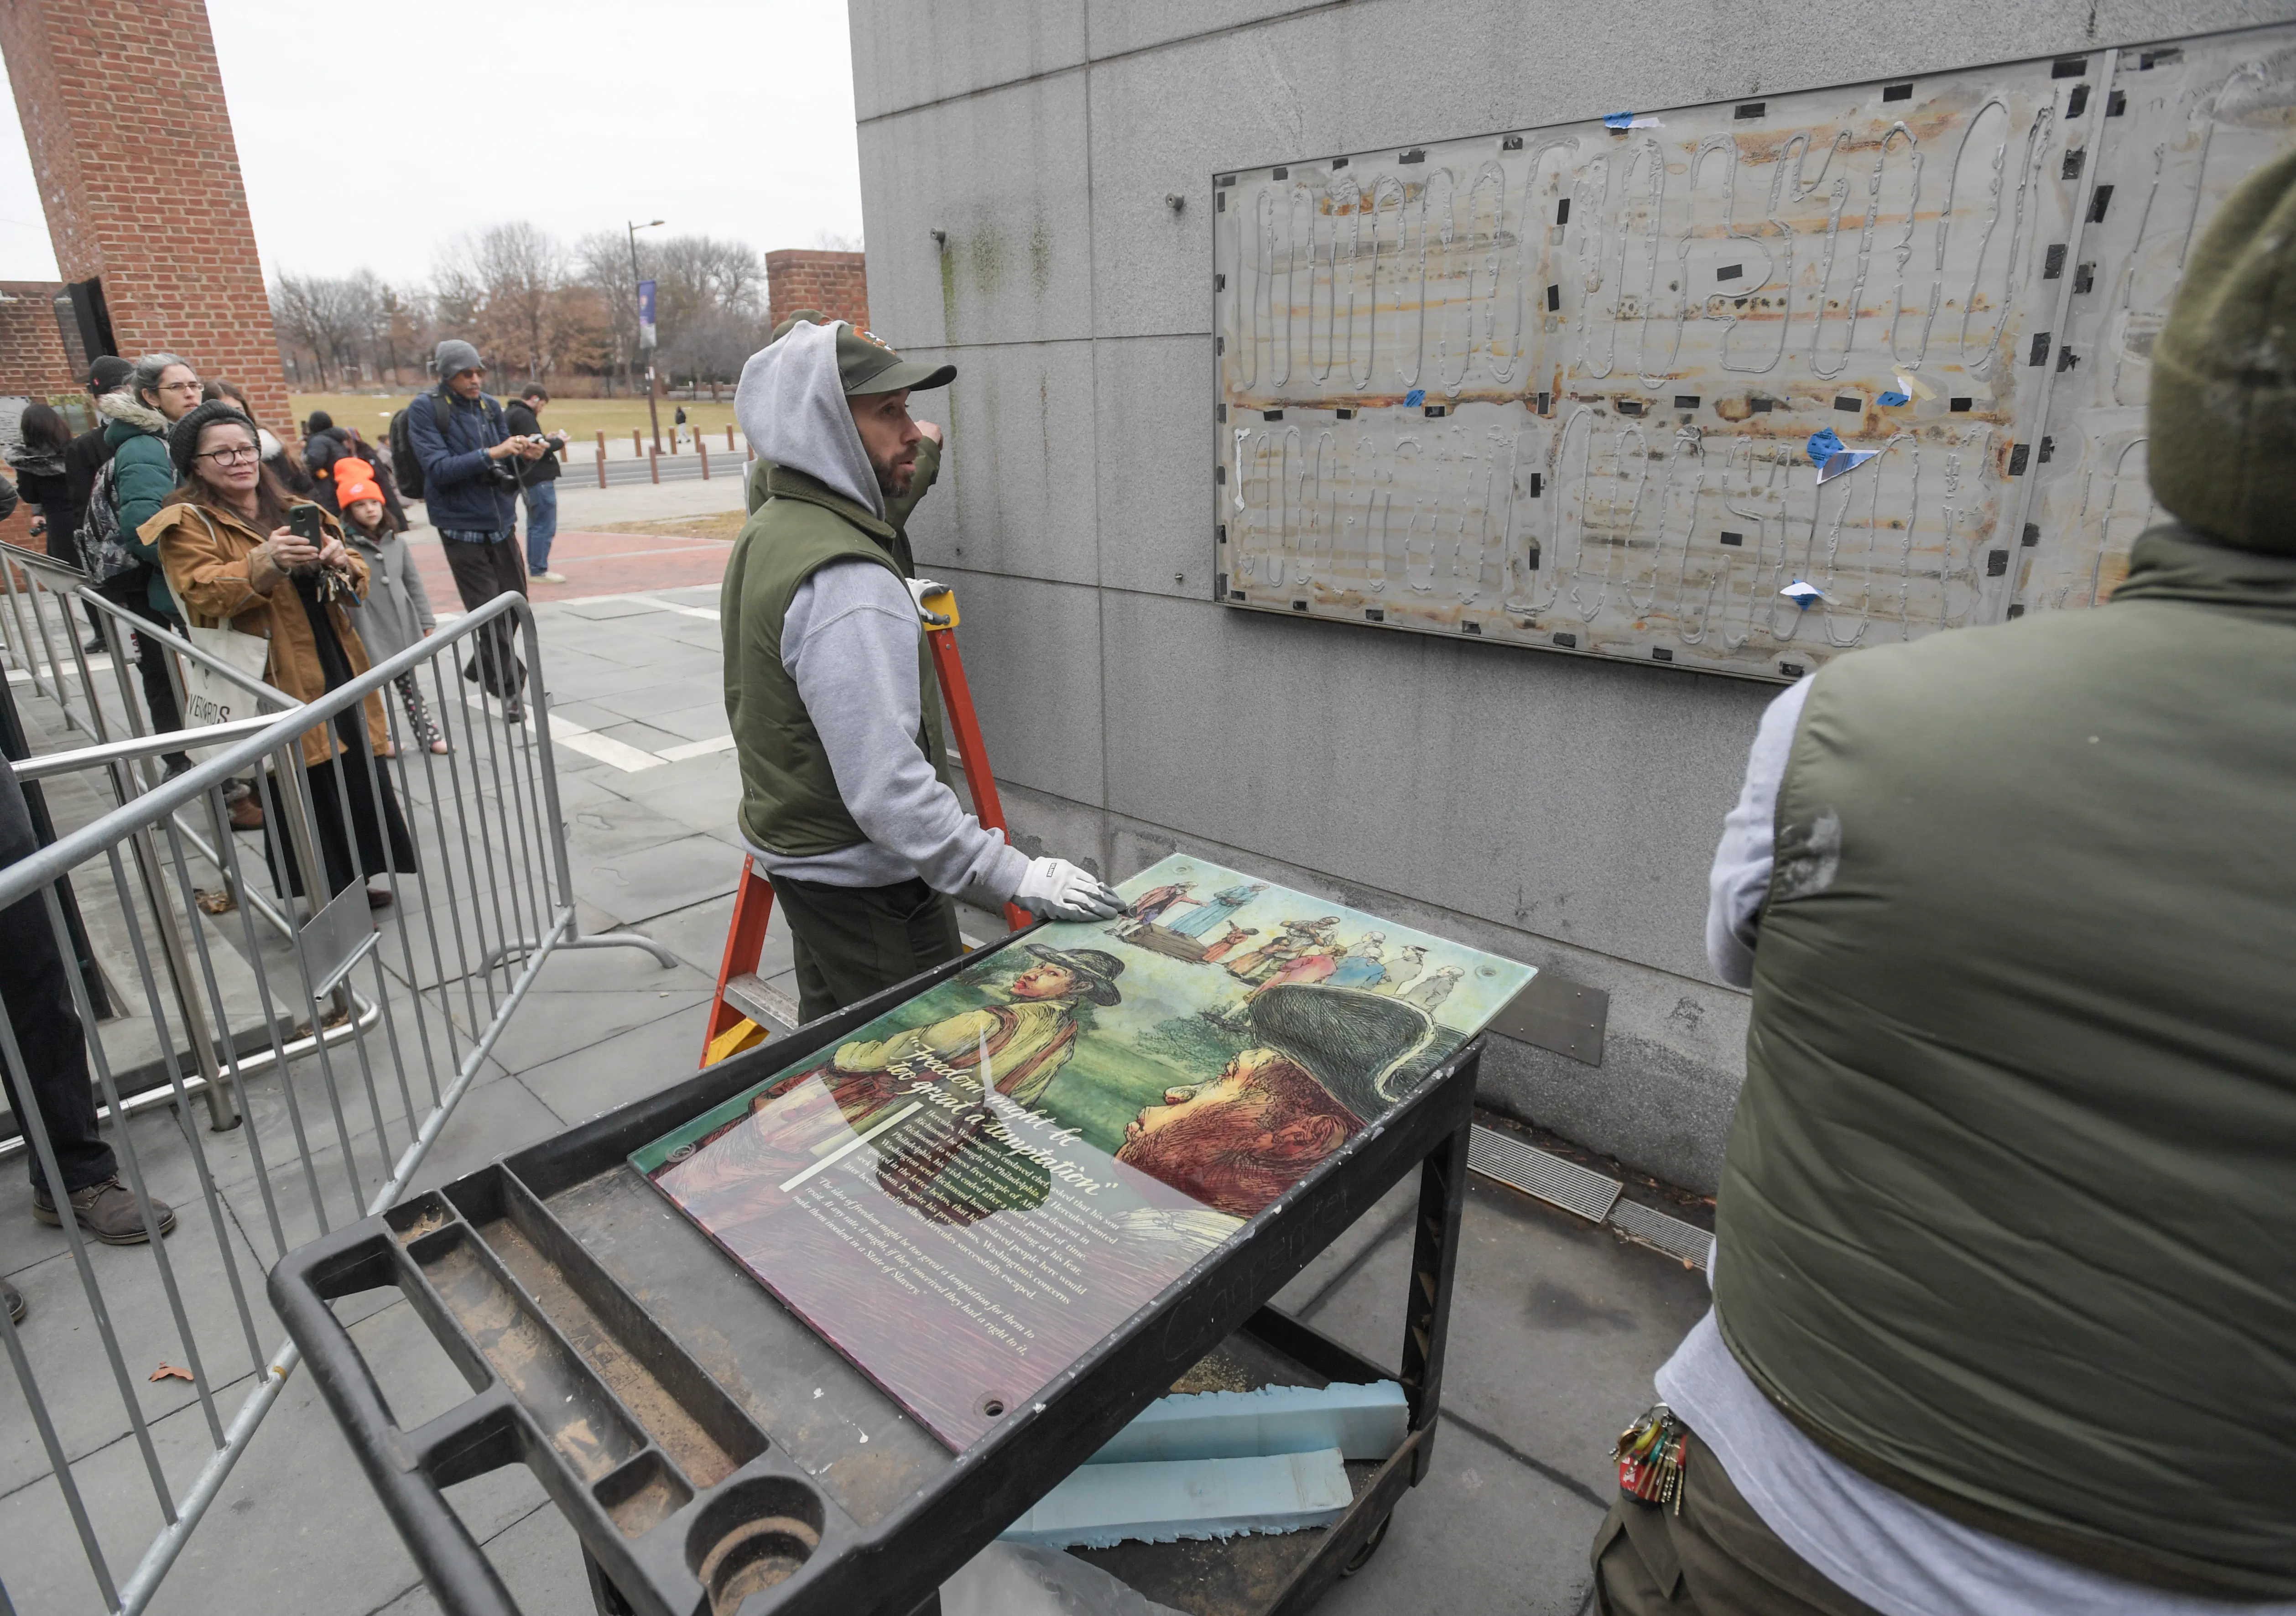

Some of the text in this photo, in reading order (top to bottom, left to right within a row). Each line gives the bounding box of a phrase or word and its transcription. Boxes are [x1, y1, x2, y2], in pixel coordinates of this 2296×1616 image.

[1046, 863, 1057, 877] ULINE
[885, 1061, 1119, 1196] too great a temptation"
[890, 1036, 1083, 1147] "Freedom might be
[791, 1195, 811, 1209] make
[807, 1207, 827, 1222] them
[824, 1220, 853, 1241] insolent
[864, 1250, 884, 1265] State
[880, 1265, 896, 1273] of
[843, 1161, 1036, 1299] later became reality when Hercules successfully escaped.
[855, 1155, 1071, 1304] seek freedom. Despite his precautions, Washington's concerns
[868, 1148, 894, 1164] quoted
[897, 1167, 911, 1177] the
[909, 1174, 930, 1190] letter
[928, 1187, 951, 1206] below,
[951, 1203, 969, 1217] that
[979, 1223, 1014, 1246] enslaved
[1009, 1244, 1039, 1263] people
[1038, 1261, 1058, 1276] here
[1059, 1275, 1087, 1294] would
[881, 1138, 1082, 1275] Washington sent Richmond home after writing of his fear,
[891, 1131, 932, 1162] Philadelphia,
[944, 1166, 962, 1179] wish
[960, 1178, 985, 1193] ended
[981, 1191, 1002, 1205] after
[1008, 1207, 1028, 1222] short
[1024, 1220, 1056, 1239] period
[1053, 1237, 1068, 1245] of
[1065, 1244, 1086, 1261] time.
[902, 1124, 939, 1147] Richmond
[945, 1151, 970, 1169] witness
[969, 1166, 985, 1178] free
[981, 1176, 1010, 1194] people
[1019, 1199, 1048, 1219] African
[1048, 1217, 1080, 1238] descent
[914, 1116, 951, 1140] Richmond
[956, 1142, 985, 1163] brought
[993, 1165, 1039, 1198] Philadelphia.
[1050, 1201, 1086, 1225] Hercules
[1087, 1224, 1118, 1244] wanted
[926, 1109, 1119, 1230] Hercules, Washington's enslaved chef, asked that his son
[804, 1187, 825, 1202] resist.
[830, 1207, 845, 1217] any
[842, 1215, 859, 1230] rate,
[864, 1232, 889, 1251] might,
[884, 1248, 900, 1256] if
[894, 1254, 912, 1268] they
[910, 1267, 949, 1293] conceived
[943, 1291, 963, 1306] they
[960, 1303, 982, 1318] had
[984, 1322, 1009, 1339] right
[830, 1187, 847, 1200] idea
[843, 1199, 859, 1209] of
[855, 1204, 880, 1225] freedom
[878, 1224, 902, 1240] might
[908, 1245, 922, 1256] too
[917, 1255, 944, 1271] great
[947, 1274, 990, 1308] temptation
[983, 1302, 1004, 1315] for
[1002, 1314, 1025, 1331] them
